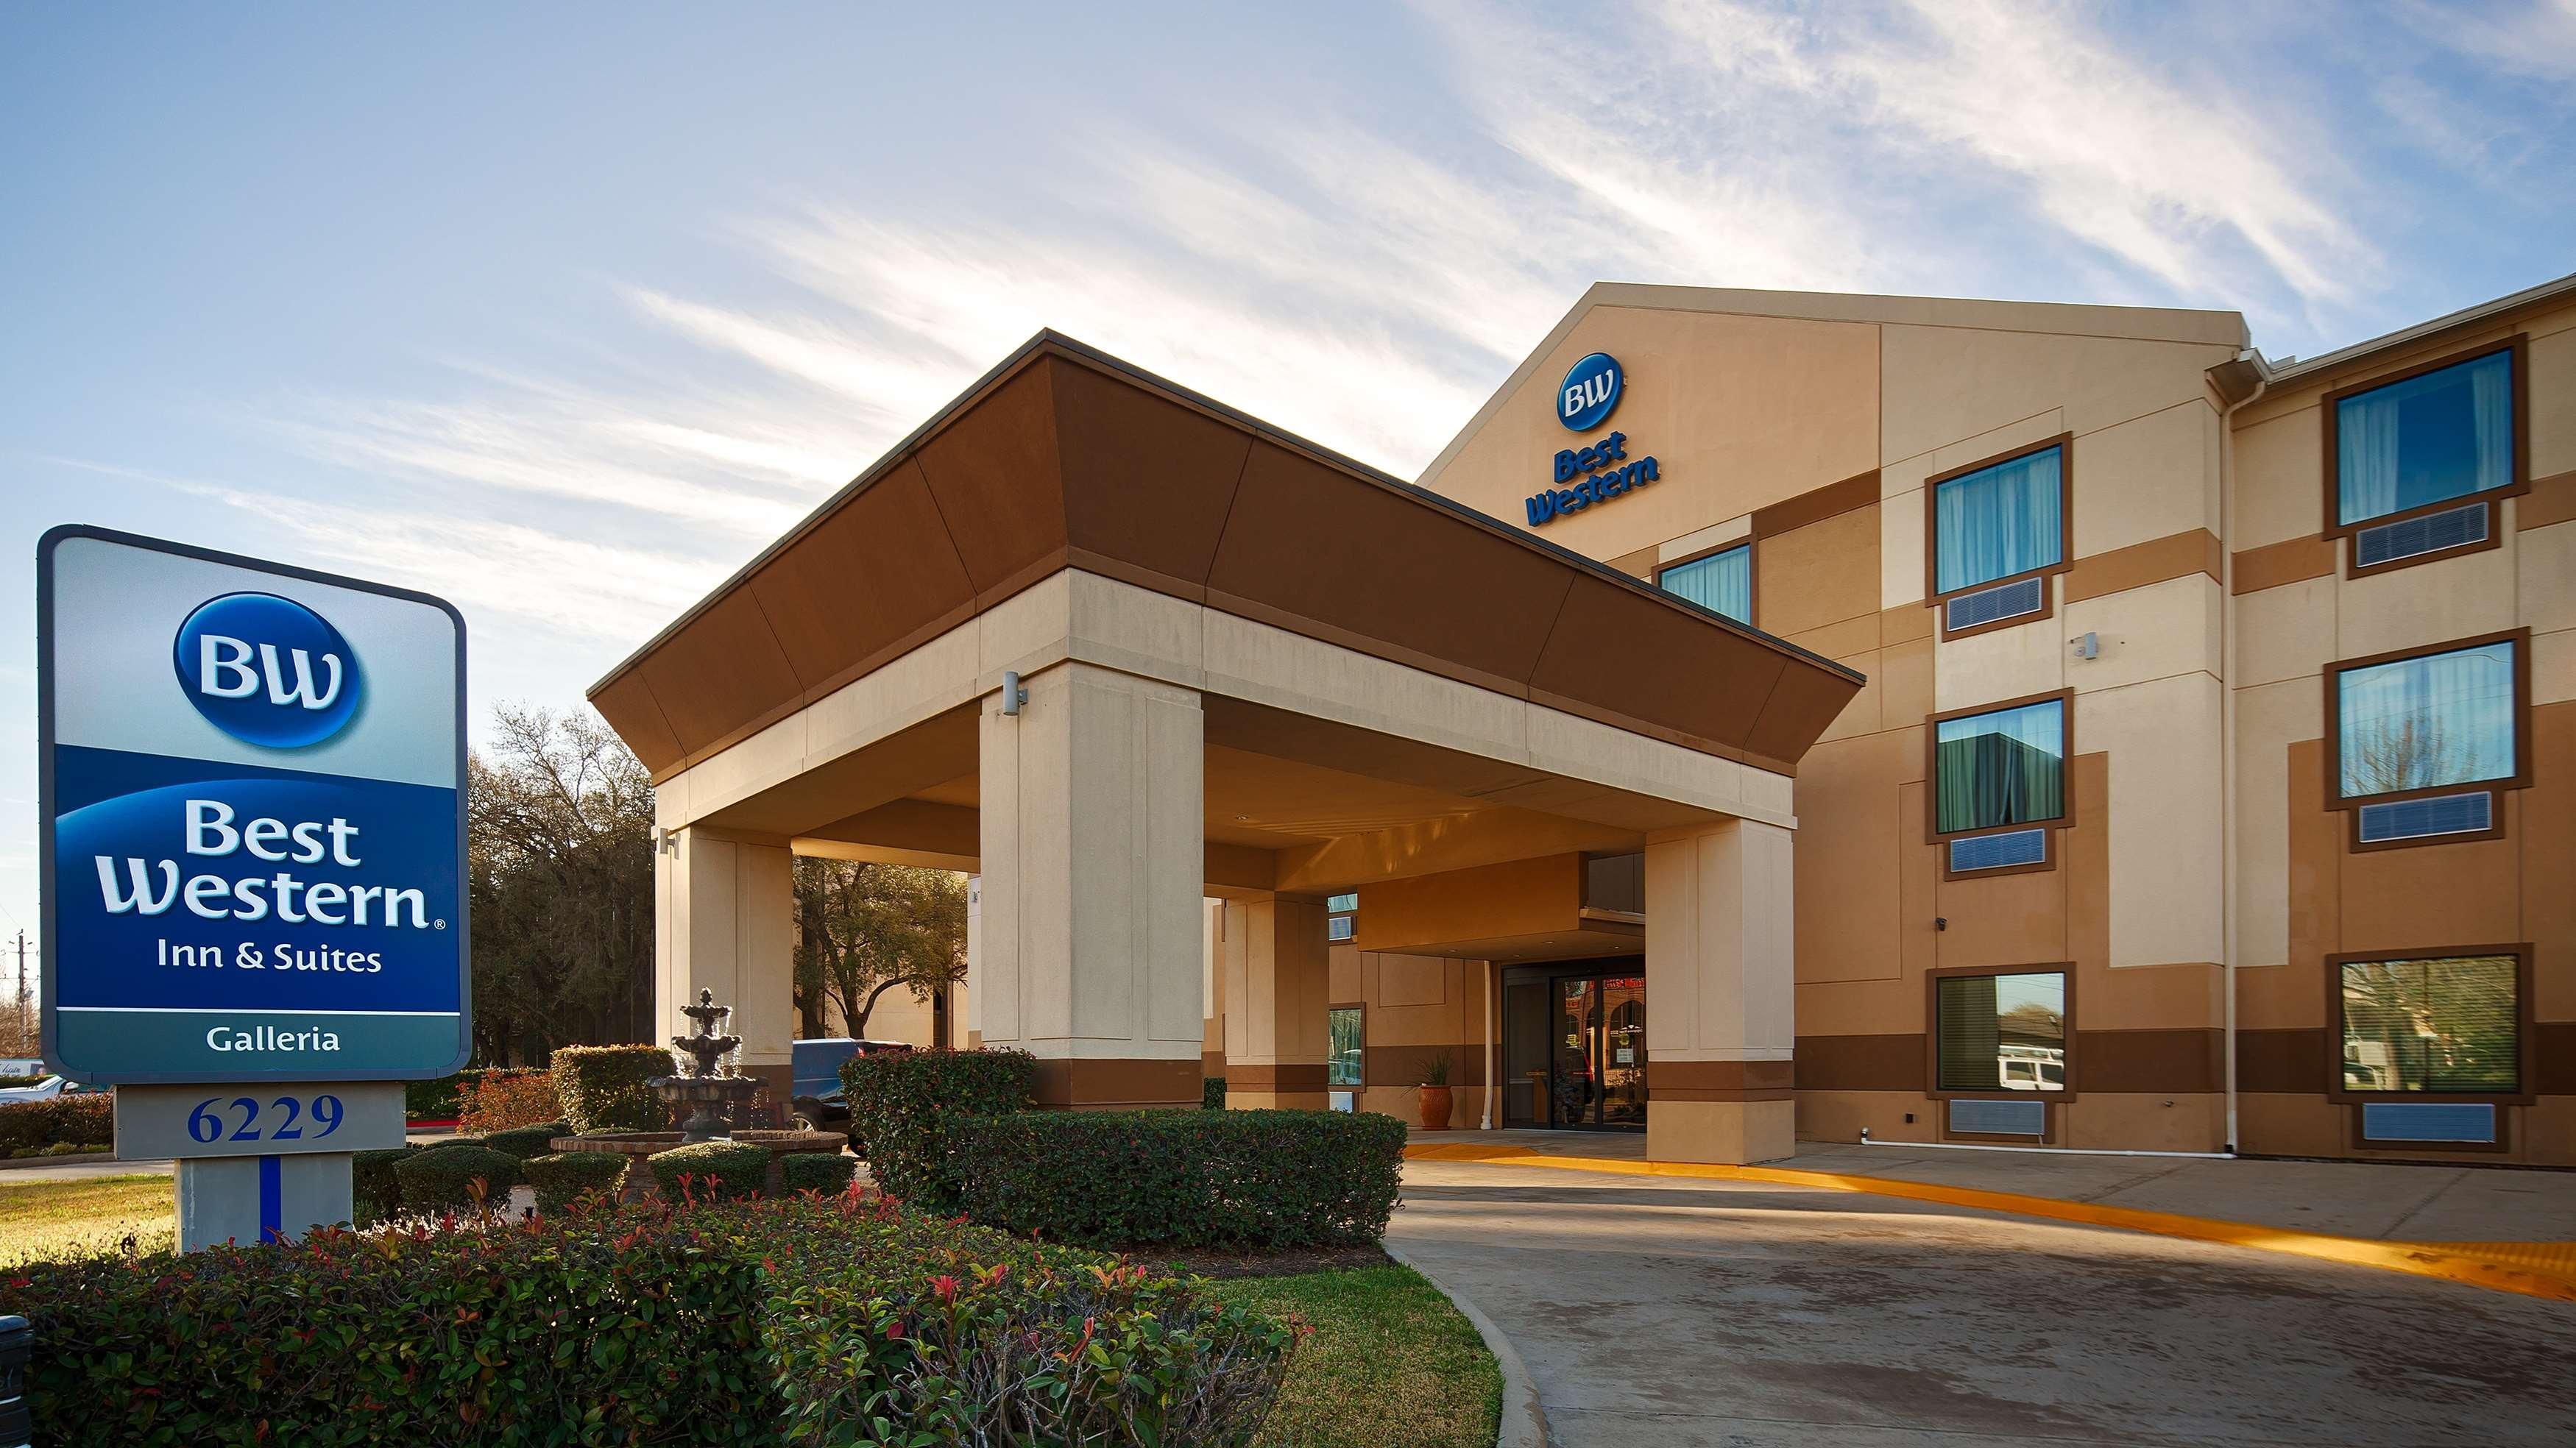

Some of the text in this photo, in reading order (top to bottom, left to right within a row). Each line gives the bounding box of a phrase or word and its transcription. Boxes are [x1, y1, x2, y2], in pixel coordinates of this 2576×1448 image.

[1565, 369, 1614, 417] BW
[1554, 430, 1627, 483] Best
[1526, 455, 1660, 527] Western
[200, 634, 342, 709] BW
[185, 799, 361, 867] Best
[158, 938, 382, 973] Inn & Suites
[206, 1026, 341, 1052] Galleria
[188, 1095, 344, 1143] 6229
